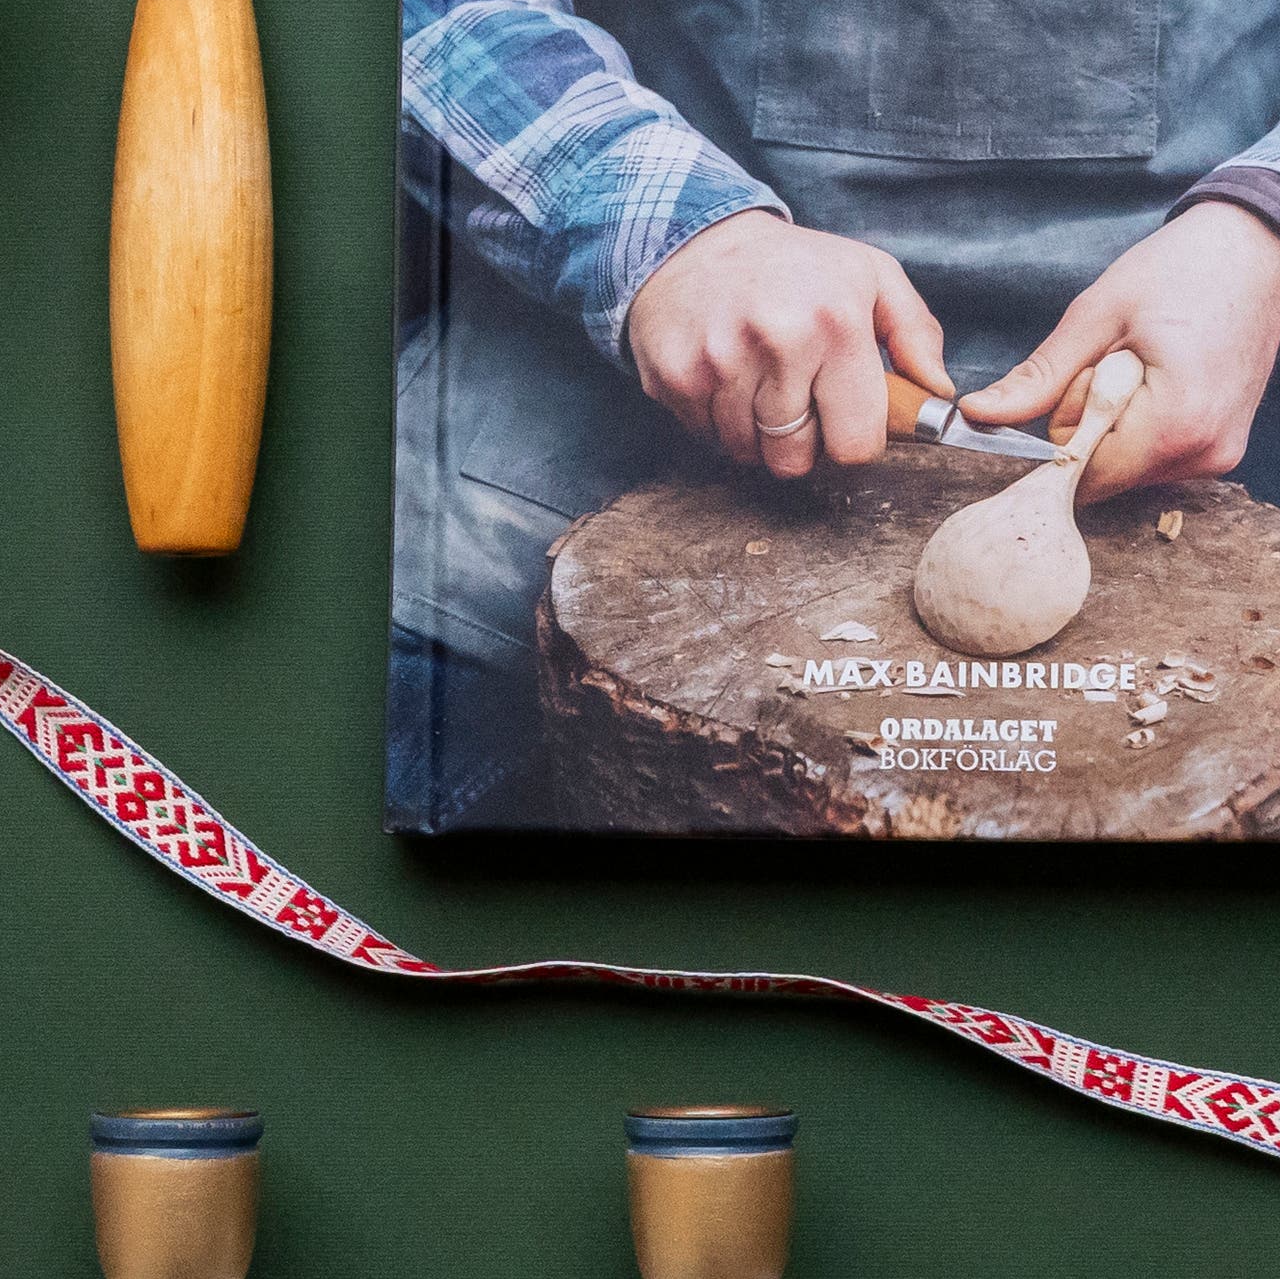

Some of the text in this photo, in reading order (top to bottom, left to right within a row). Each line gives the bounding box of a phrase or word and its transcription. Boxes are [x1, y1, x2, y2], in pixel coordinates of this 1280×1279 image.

[803, 659, 1137, 690] MAX BAINBRIDGE
[880, 718, 1057, 742] ORDALAGET
[880, 745, 1057, 771] BOKFÖRLAG
